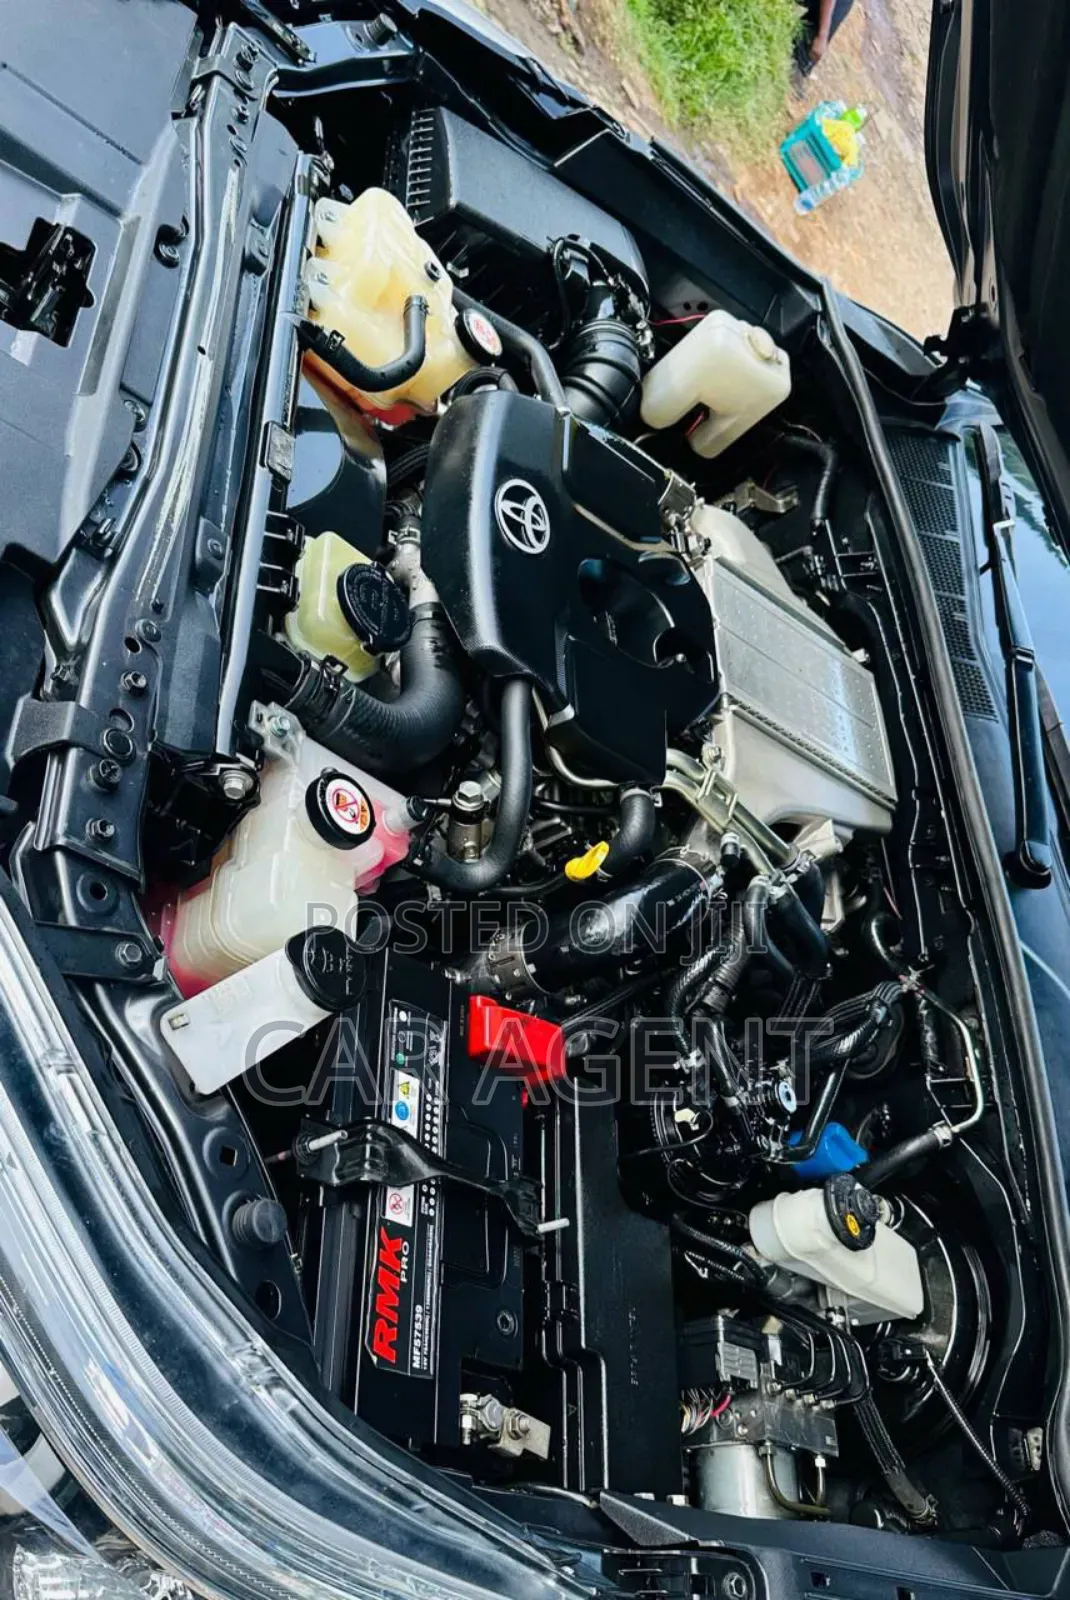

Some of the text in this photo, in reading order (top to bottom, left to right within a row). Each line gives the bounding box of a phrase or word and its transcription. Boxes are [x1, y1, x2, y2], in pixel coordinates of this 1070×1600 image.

[400, 1240, 410, 1283] PRO
[373, 1227, 402, 1363] RMK
[411, 1304, 423, 1369] MF57539
